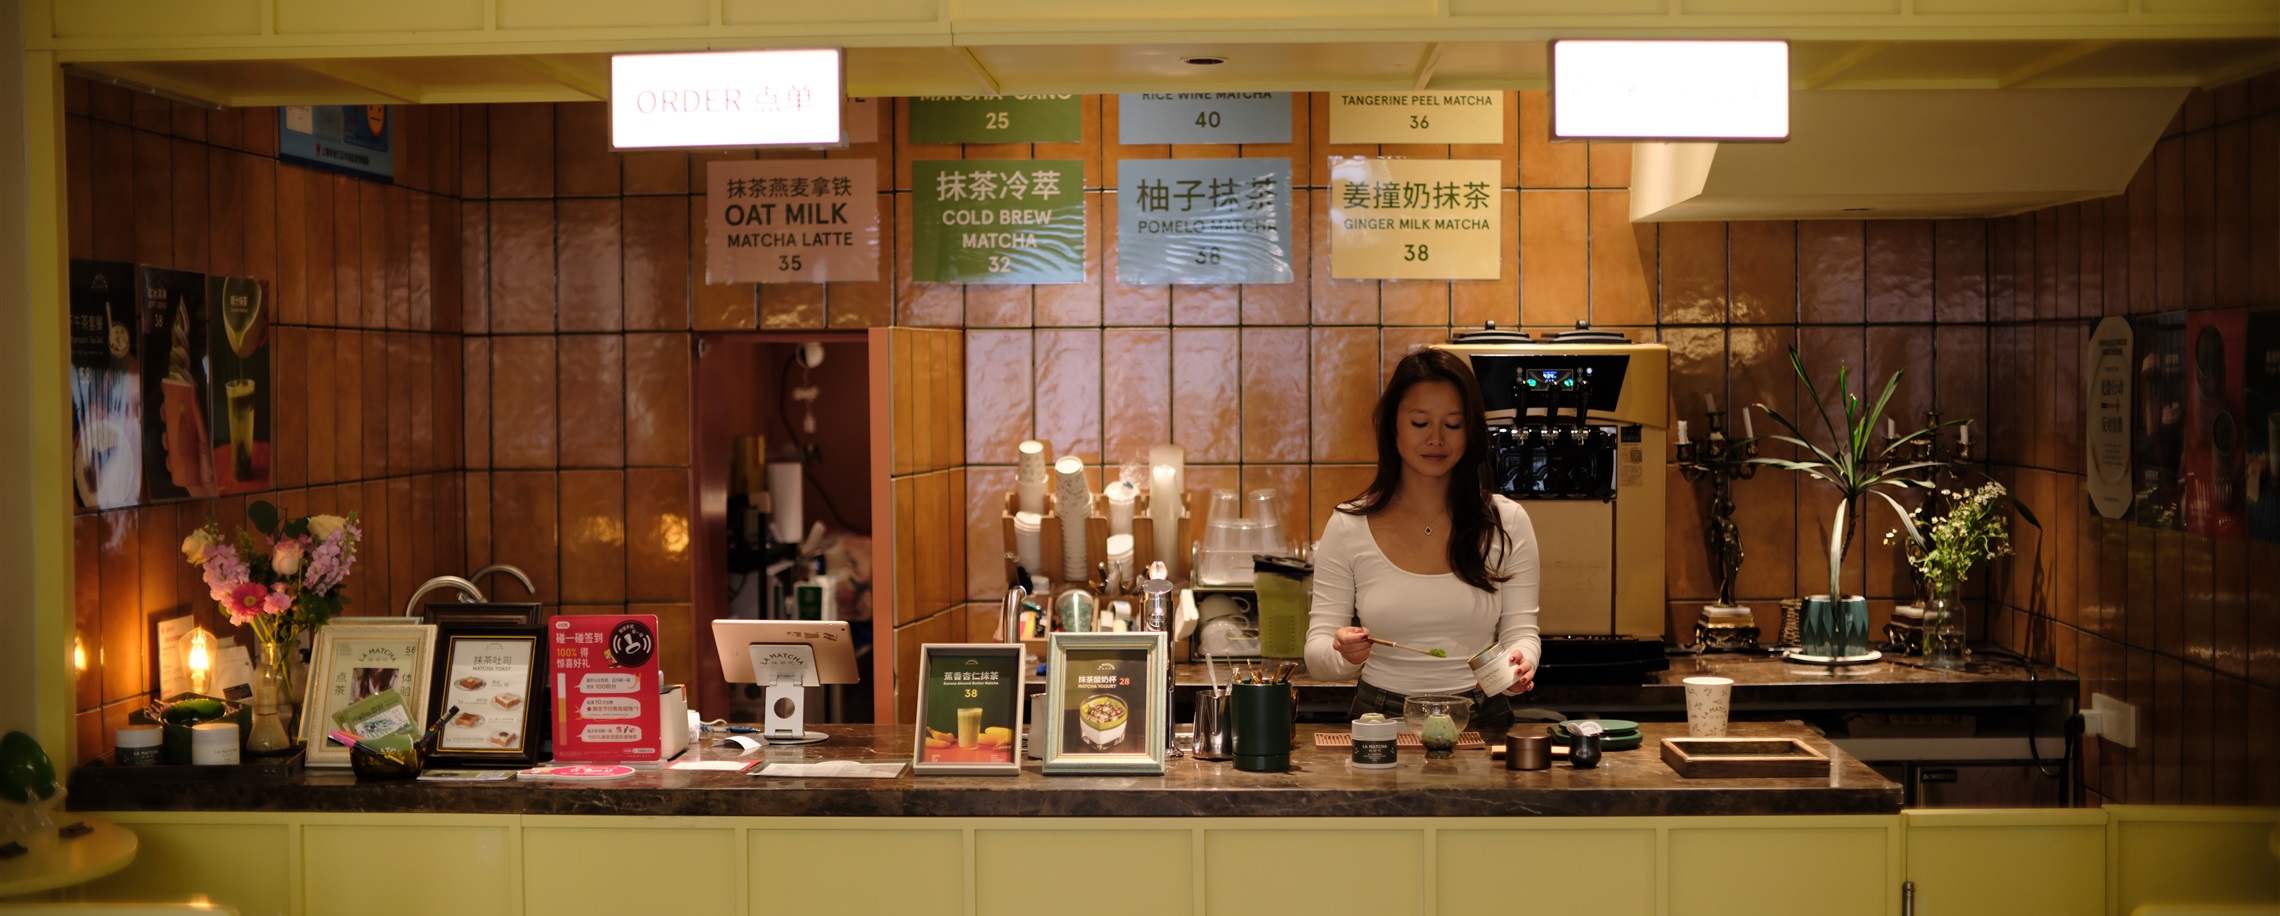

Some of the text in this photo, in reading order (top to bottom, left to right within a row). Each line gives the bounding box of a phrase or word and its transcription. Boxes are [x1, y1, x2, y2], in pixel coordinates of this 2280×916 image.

[637, 85, 813, 114] ORDER 点单
[1142, 91, 1272, 100] RICE WINE MATCHA
[1341, 95, 1493, 106] TANGERINE PEEL MATCHA
[985, 112, 1009, 129] 25
[1194, 111, 1220, 128] 40
[1409, 115, 1430, 129] 36
[727, 176, 852, 199] 抹茶燕麦拿铁
[936, 170, 1061, 201] 抹茶冷萃
[1136, 177, 1277, 212] 柚子抹茶
[1343, 181, 1491, 210] 姜撞奶抹茶
[725, 202, 848, 226] OAT MILK
[942, 210, 1052, 225] COLD BREW
[1137, 221, 1204, 234] POMELO
[1343, 218, 1490, 231] GINGER MILK MATCHA
[727, 231, 853, 248] MATCHA LATTE
[962, 233, 1037, 248] MATCHA
[1195, 247, 1220, 264] 38
[1404, 244, 1429, 262] 38
[778, 254, 801, 271] 35
[988, 256, 1010, 273] 32
[555, 632, 604, 644] 碰一碰签到
[358, 647, 398, 663] LA MATCHA
[557, 647, 589, 657] 100% 得
[769, 652, 804, 665] MATCHA
[474, 655, 512, 666] 抹茶吐司
[557, 658, 590, 669] 惊喜好礼
[943, 671, 999, 681] 蕉香杏仁抹茶
[1077, 675, 1117, 684] 抹茶酸奶杯
[1119, 677, 1130, 686] 28
[334, 672, 347, 696] 点茶
[400, 673, 412, 697] 体验
[964, 689, 978, 698] 38
